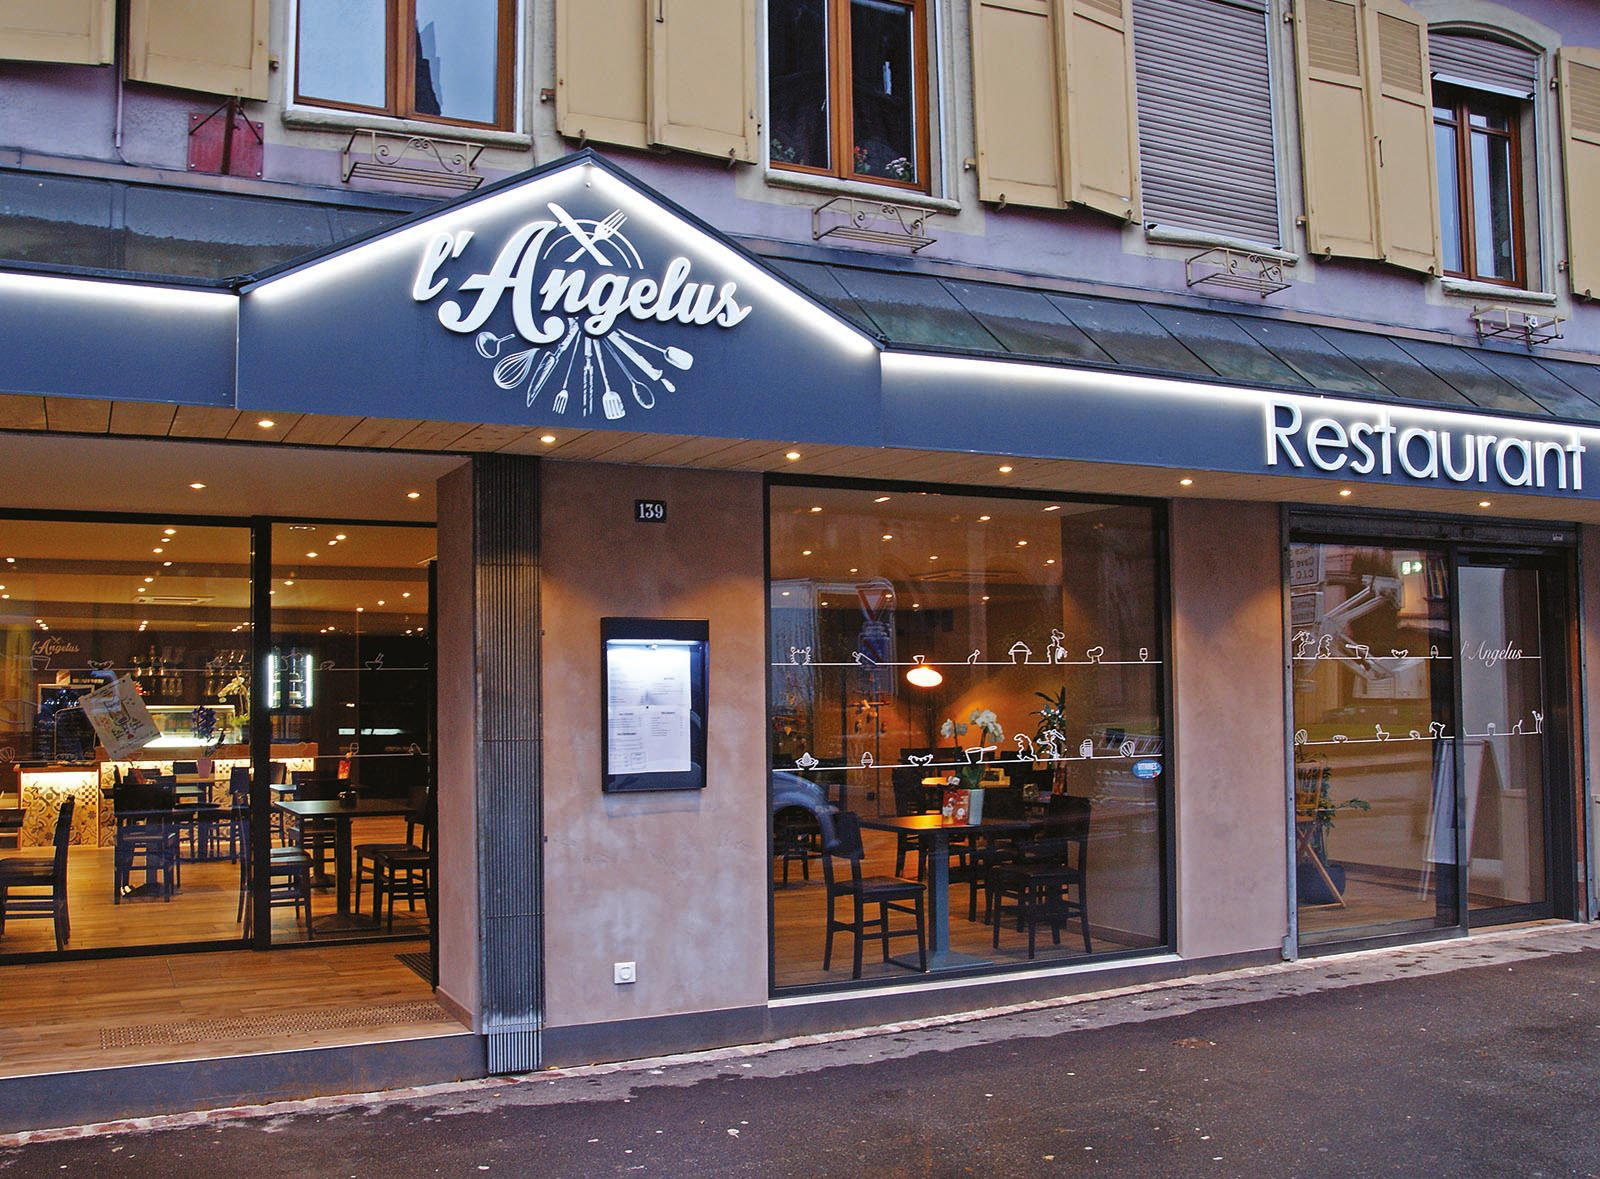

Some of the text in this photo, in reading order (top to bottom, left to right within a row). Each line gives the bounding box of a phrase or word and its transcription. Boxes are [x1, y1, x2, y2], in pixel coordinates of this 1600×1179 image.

[412, 221, 752, 344] l'Angelus
[1264, 400, 1586, 490] Restaurant
[640, 503, 664, 519] 139
